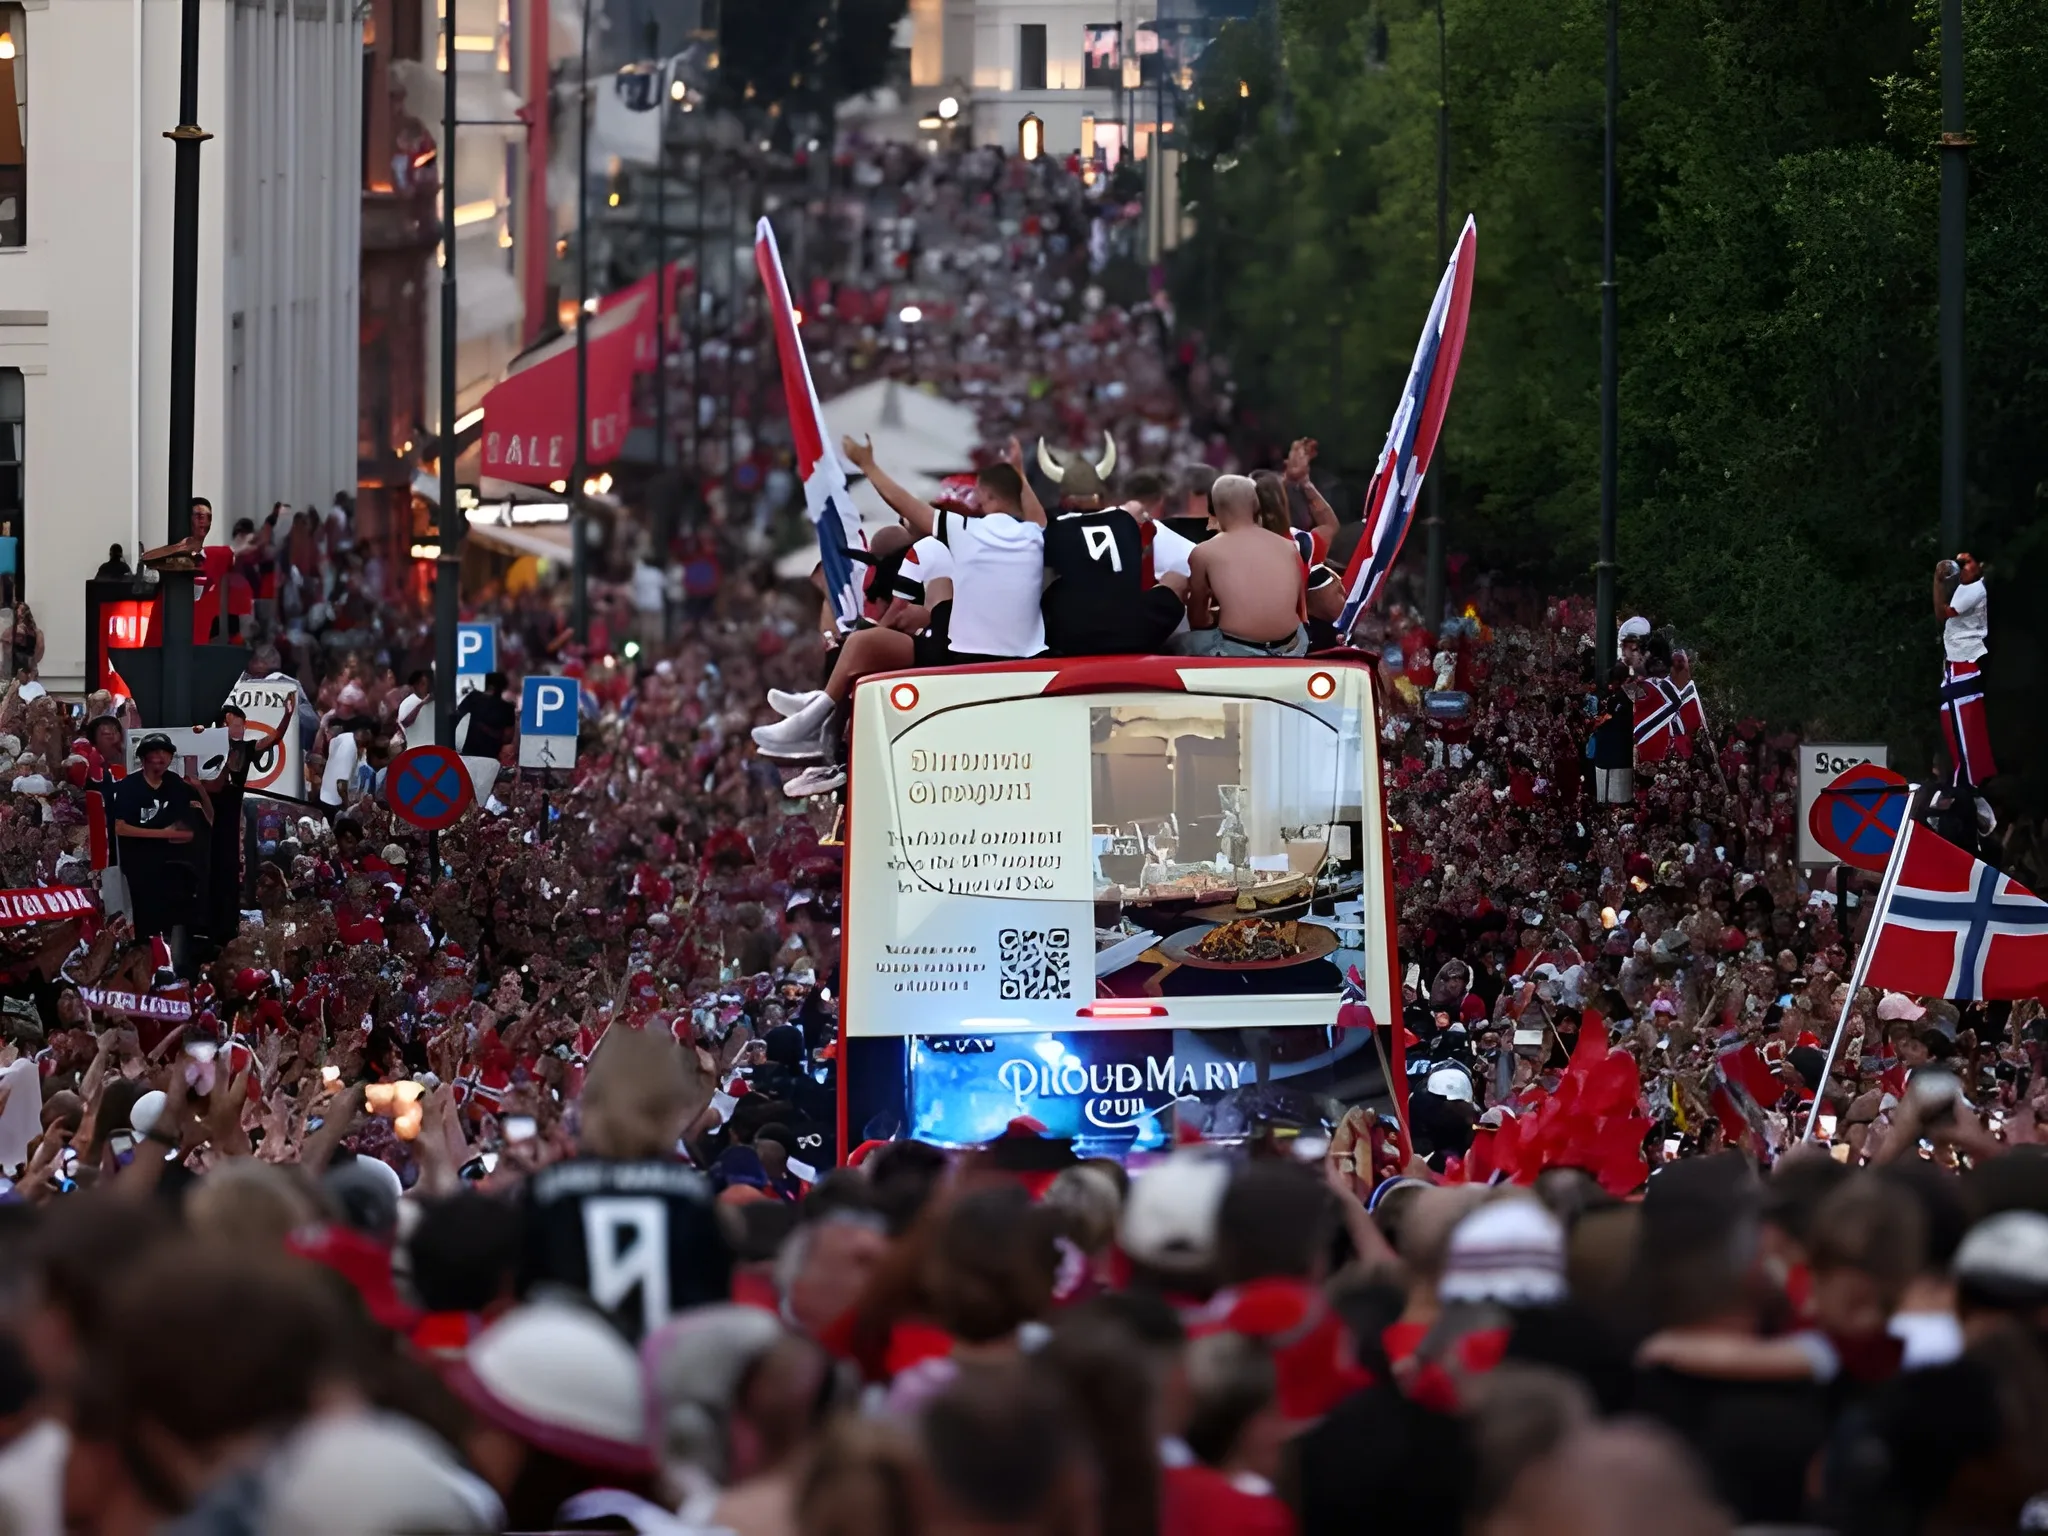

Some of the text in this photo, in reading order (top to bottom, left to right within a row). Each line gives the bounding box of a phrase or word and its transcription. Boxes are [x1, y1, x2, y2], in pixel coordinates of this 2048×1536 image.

[1081, 525, 1122, 572] 9
[458, 631, 482, 667] P
[536, 685, 564, 727] P
[582, 1196, 671, 1330] 9
